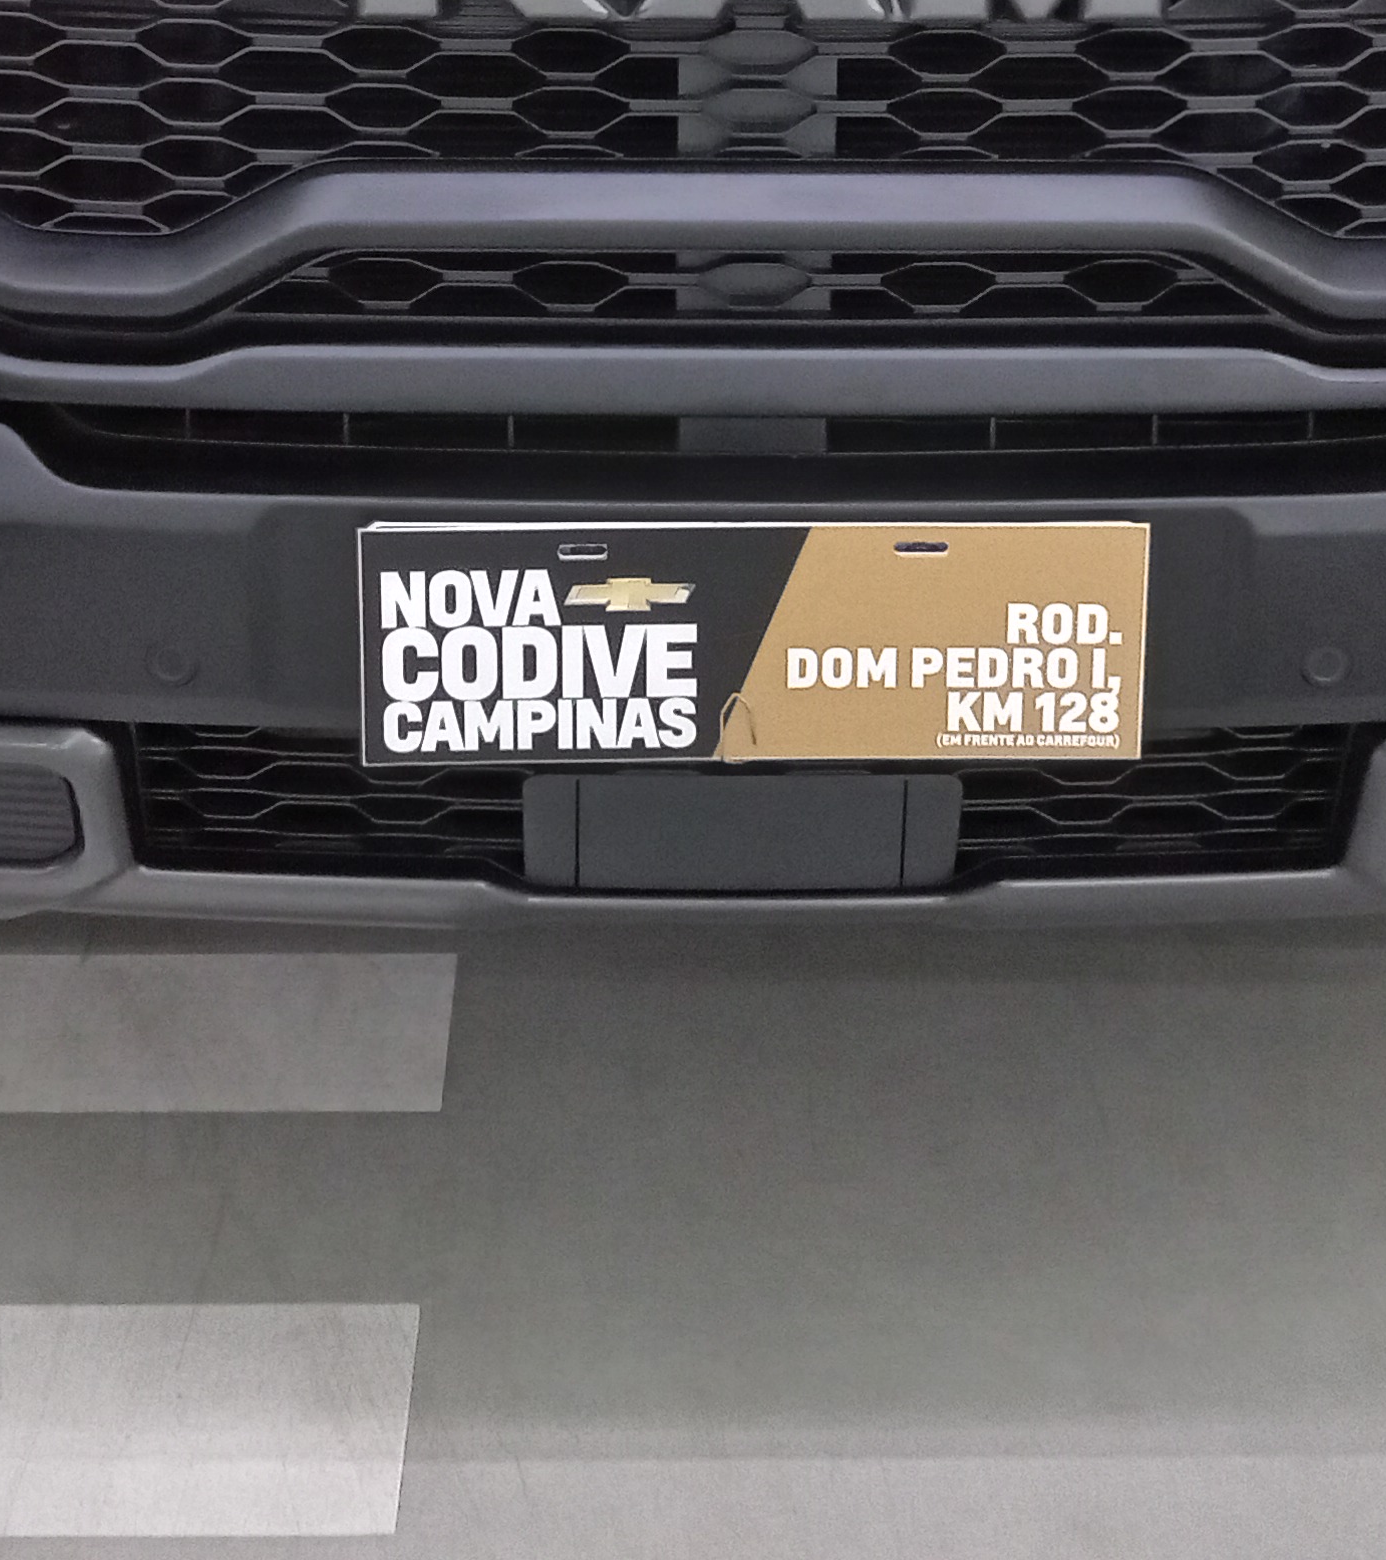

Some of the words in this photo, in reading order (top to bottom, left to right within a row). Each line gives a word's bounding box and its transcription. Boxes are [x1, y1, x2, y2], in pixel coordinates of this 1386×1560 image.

[380, 569, 562, 629] NOVA
[1006, 601, 1123, 646] ROD.
[382, 623, 698, 702] CODIVE
[786, 646, 898, 689] DOM
[911, 646, 1079, 689] PEDRO
[1091, 646, 1122, 694] I,
[383, 697, 697, 753] CAMPINAS
[947, 691, 1024, 732] KM
[1034, 691, 1120, 734] 128
[936, 733, 962, 748] (EM
[964, 733, 1013, 747] FRENTE
[1016, 733, 1034, 747] AO
[1036, 733, 1120, 749] CARREFOUR)
